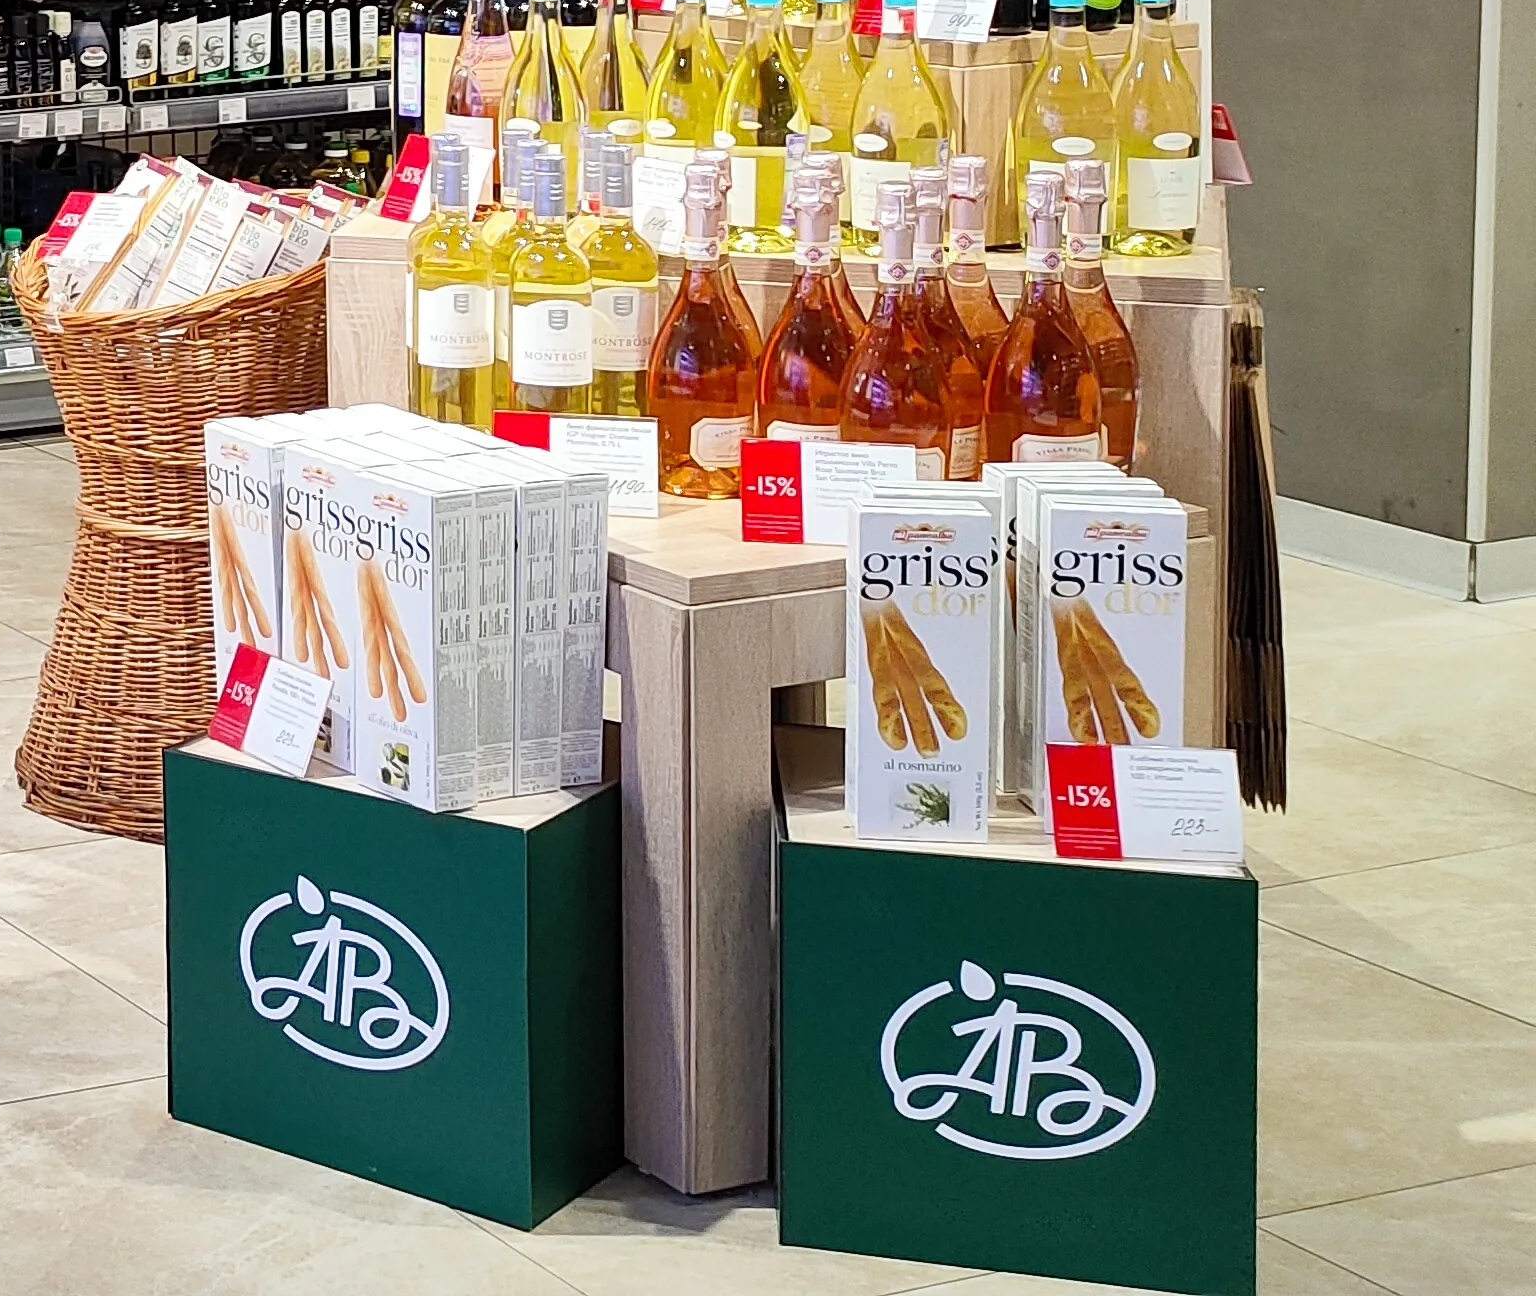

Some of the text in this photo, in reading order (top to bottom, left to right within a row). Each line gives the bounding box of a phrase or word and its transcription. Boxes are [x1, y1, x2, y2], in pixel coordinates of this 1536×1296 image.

[396, 167, 425, 185] -15%
[243, 222, 260, 240] bio
[289, 233, 308, 247] eko
[292, 221, 309, 240] bio
[239, 235, 259, 249] eko
[524, 351, 587, 362] MONTROSE
[208, 463, 270, 510] griss
[746, 475, 797, 497] -15%
[285, 486, 356, 536] griss
[356, 515, 431, 564] griss
[860, 546, 990, 600] griss
[1050, 544, 1184, 598] griss
[226, 681, 256, 707] -15%
[884, 759, 962, 773] al rosmarino
[1056, 785, 1112, 808] -15%
